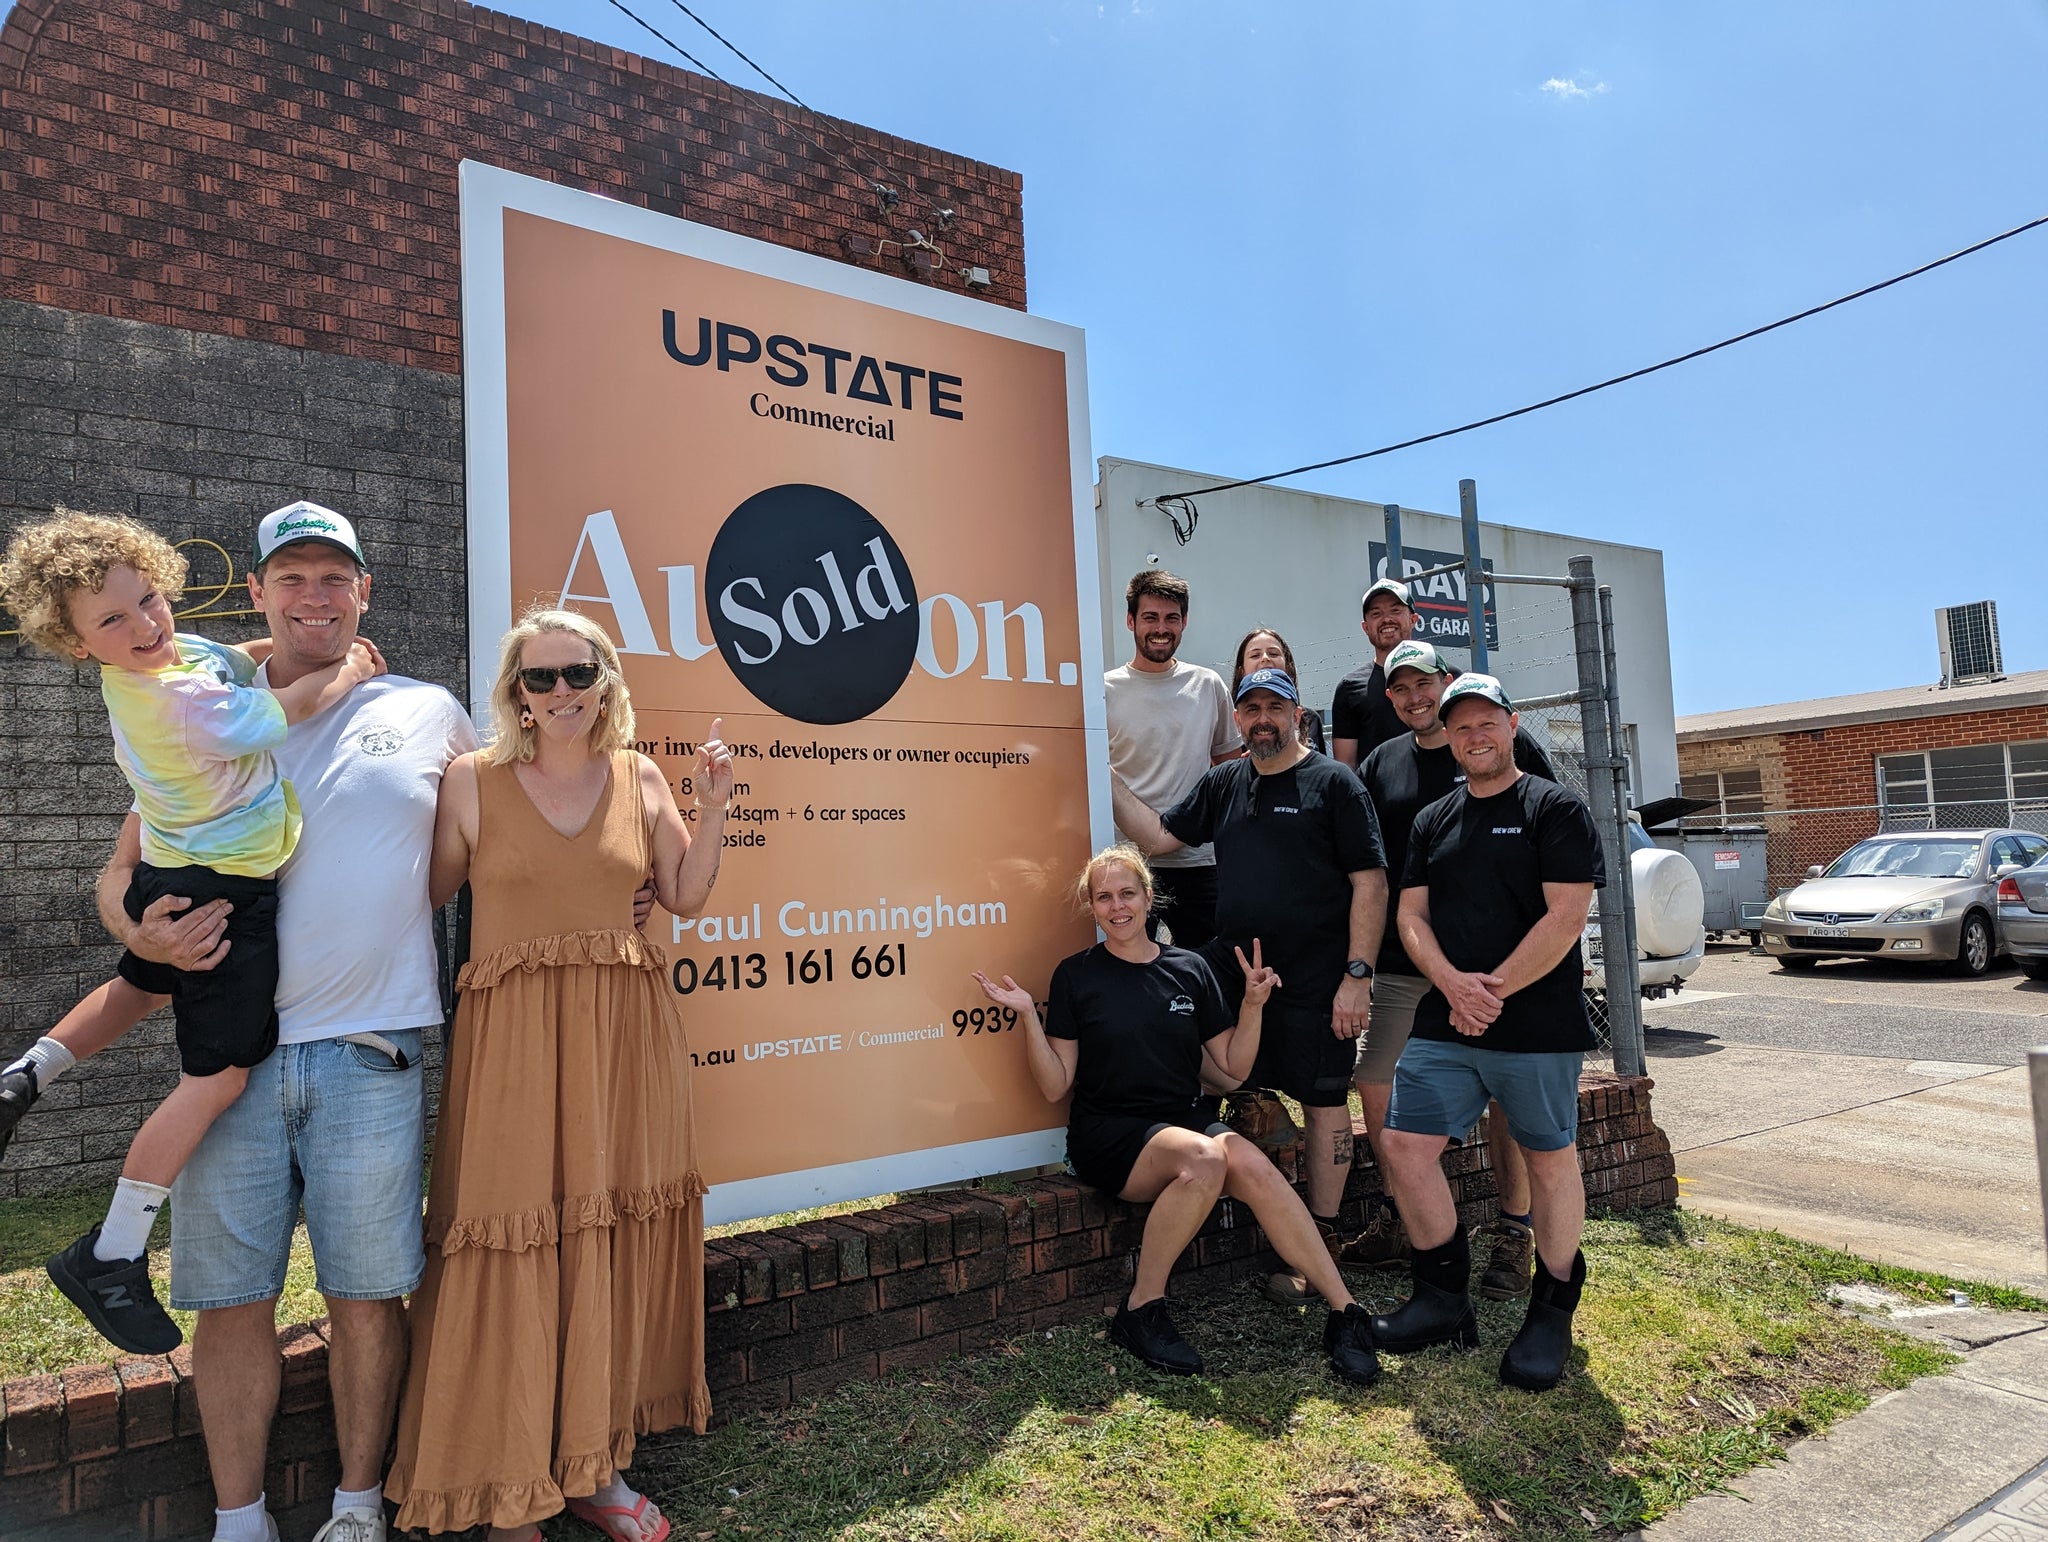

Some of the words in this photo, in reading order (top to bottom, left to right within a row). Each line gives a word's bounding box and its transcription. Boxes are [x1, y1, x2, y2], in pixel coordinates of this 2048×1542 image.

[662, 308, 964, 421] UPSTATE
[750, 392, 895, 441] Commercial
[719, 536, 911, 665] Sold
[630, 740, 658, 755] or
[769, 740, 868, 765] developers
[872, 748, 892, 762] or
[896, 748, 950, 762] owner
[954, 747, 1030, 768] occupiers
[804, 804, 814, 821] 6
[820, 807, 846, 821] car
[852, 807, 906, 825] spaces
[672, 903, 761, 944] Paul
[778, 895, 1007, 938] Cunningham
[673, 952, 767, 995] 0413
[785, 949, 833, 985] 161
[851, 943, 906, 979] 661
[743, 1034, 842, 1061] UPSTATE
[858, 1023, 945, 1047] Commercial
[952, 1006, 1018, 1037] 9939
